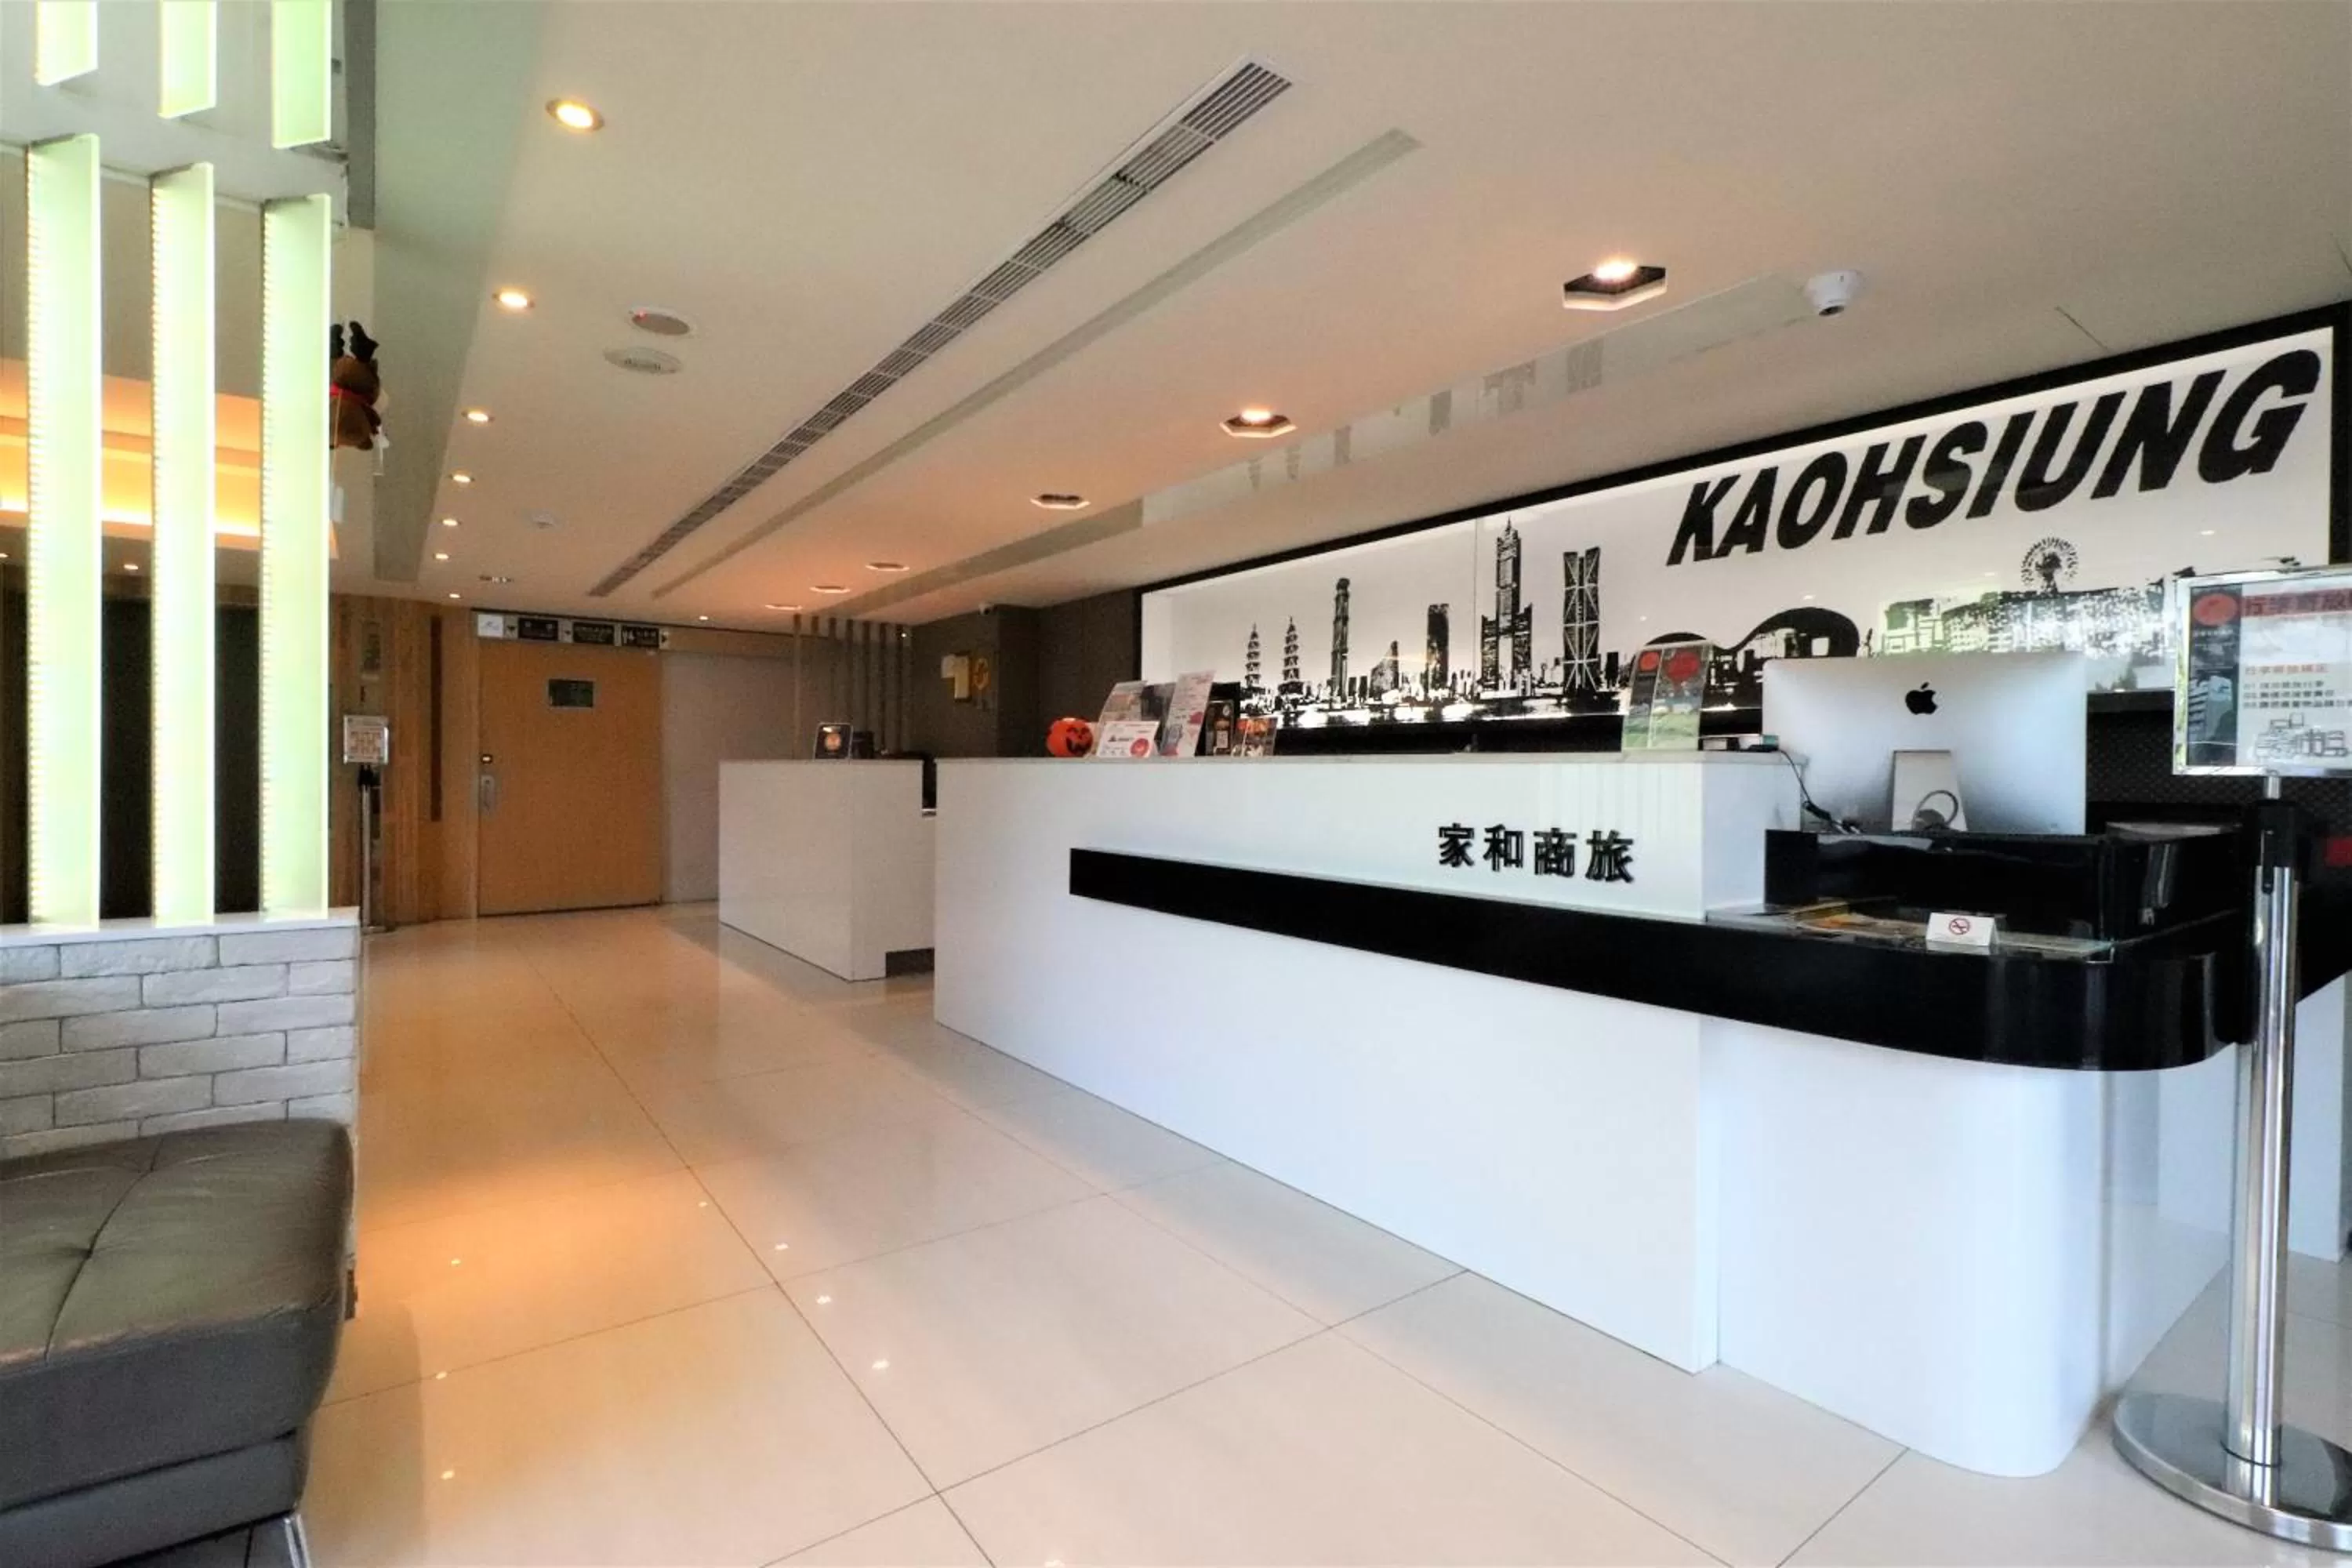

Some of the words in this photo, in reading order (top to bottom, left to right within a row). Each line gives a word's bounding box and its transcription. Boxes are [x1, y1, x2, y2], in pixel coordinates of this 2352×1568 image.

[1667, 349, 2321, 566] KAOHSIUNG
[1438, 822, 1635, 884] 家和商旅
